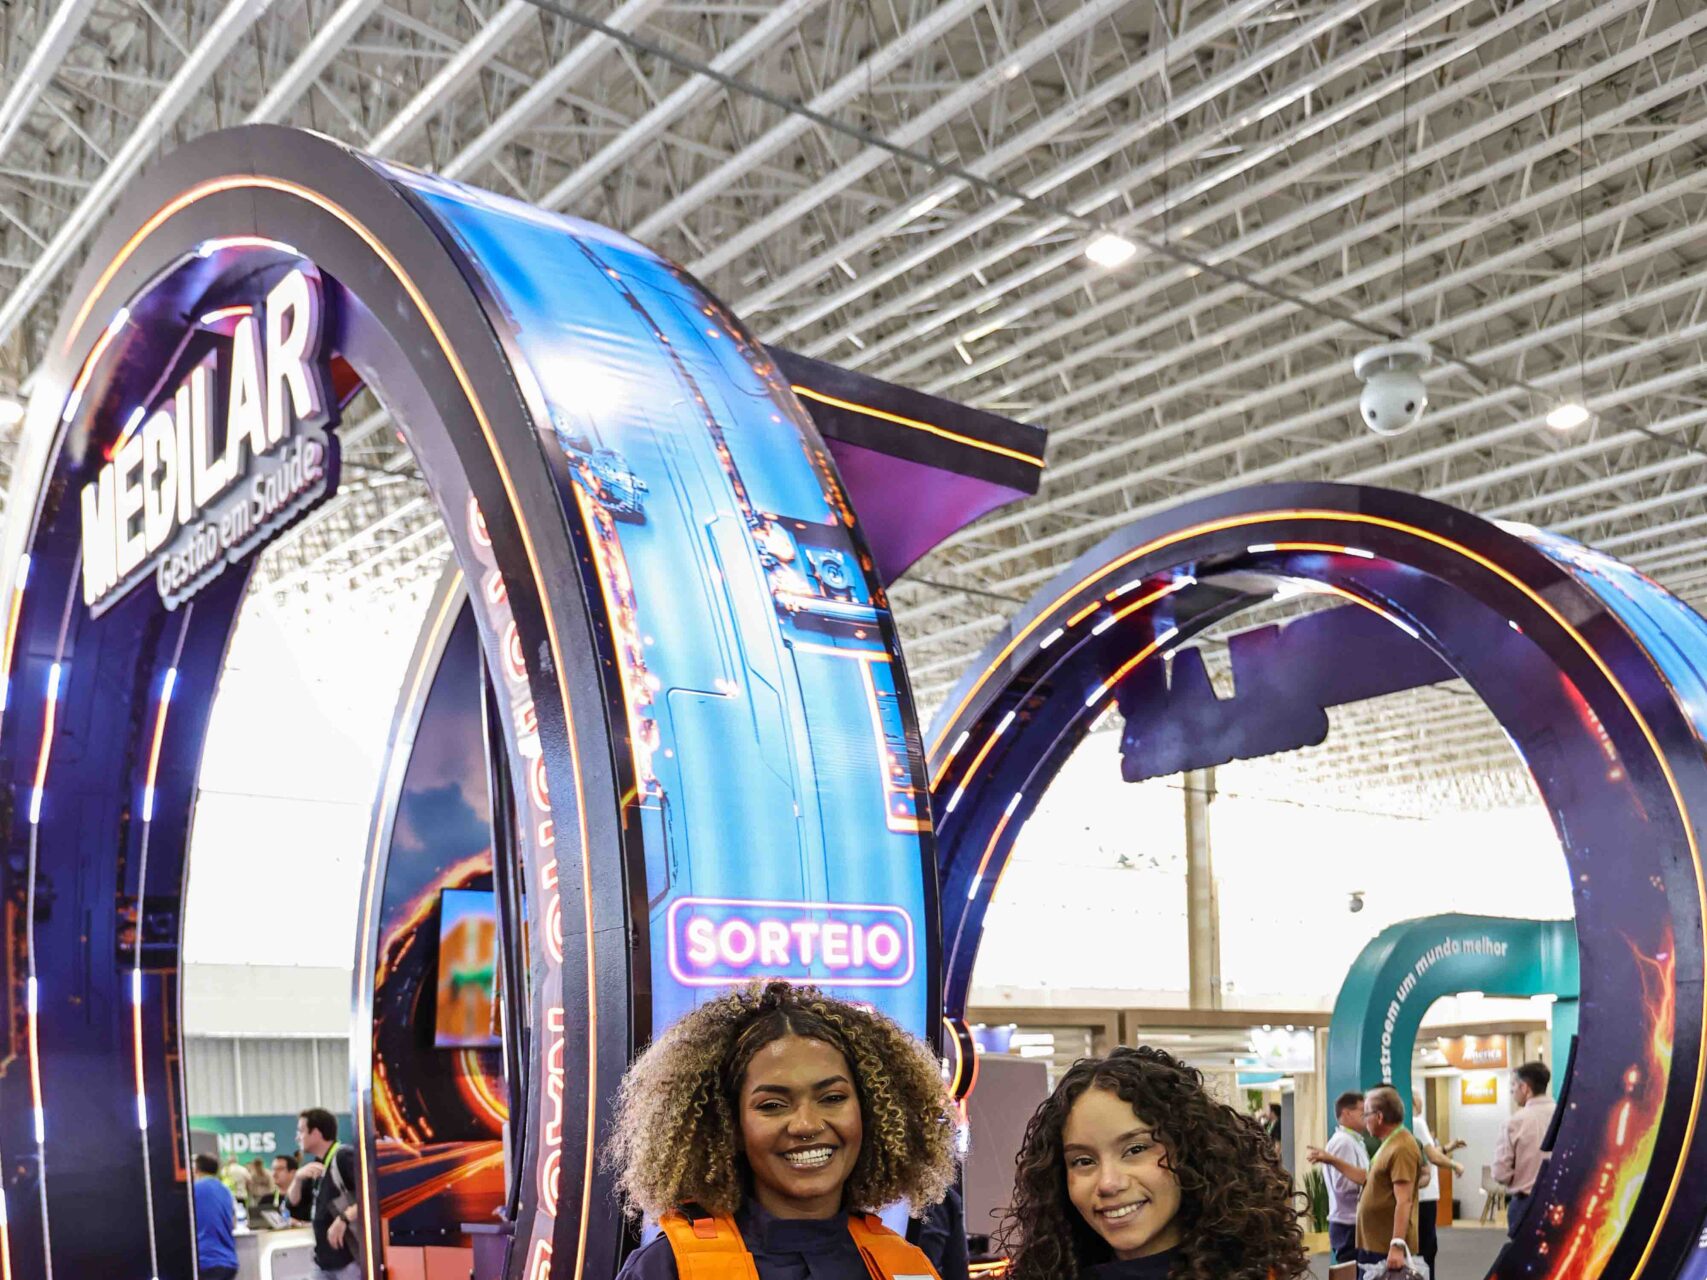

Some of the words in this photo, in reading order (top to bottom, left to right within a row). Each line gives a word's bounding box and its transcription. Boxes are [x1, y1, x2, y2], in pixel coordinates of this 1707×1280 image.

[81, 268, 313, 605] MEDILAR
[156, 520, 218, 598] Gestão
[220, 499, 251, 548] em
[251, 434, 323, 525] Saúde
[687, 916, 901, 966] SORTEIO
[1396, 972, 1417, 1003] um
[1415, 936, 1459, 977] mundo
[1462, 936, 1507, 957] melhor
[217, 1131, 277, 1153] NDES
